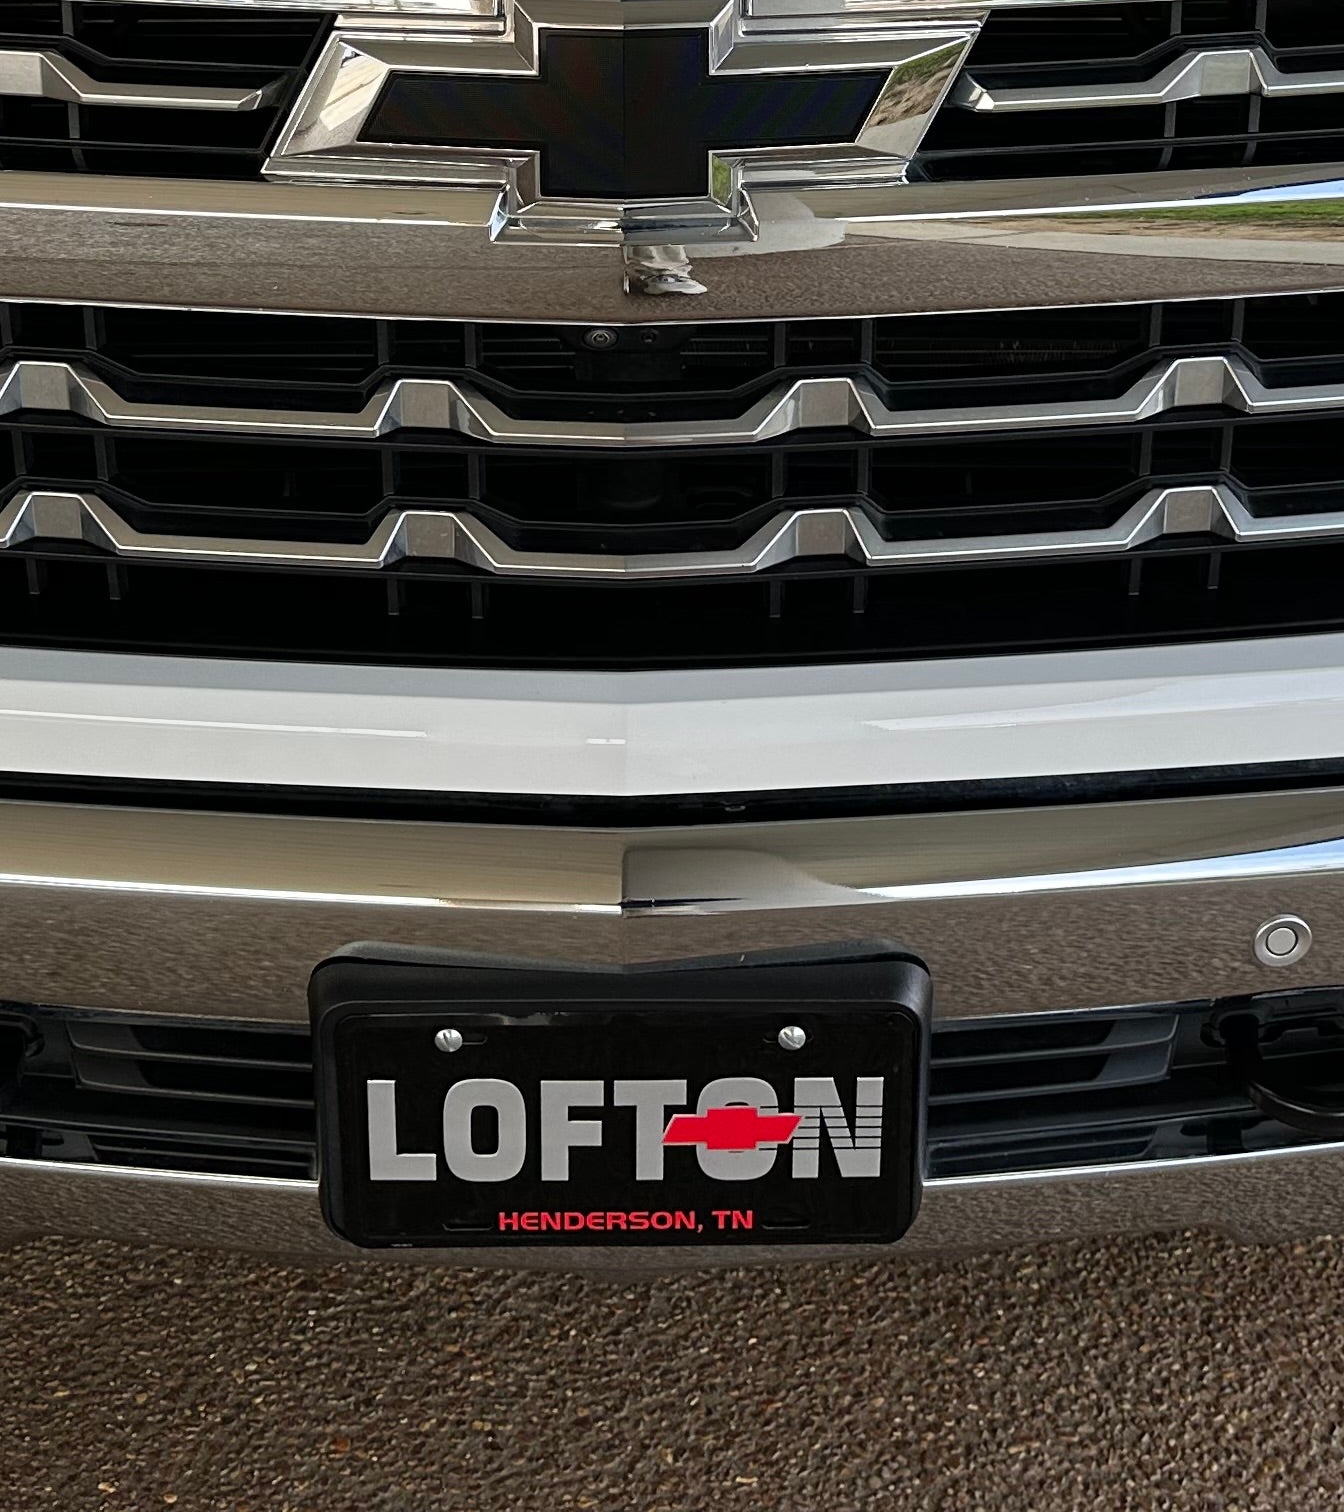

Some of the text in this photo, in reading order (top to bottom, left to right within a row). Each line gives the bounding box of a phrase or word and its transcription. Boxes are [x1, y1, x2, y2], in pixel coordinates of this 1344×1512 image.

[367, 1077, 884, 1181] LOFTON
[498, 1210, 753, 1233] HENDERSON, TN
